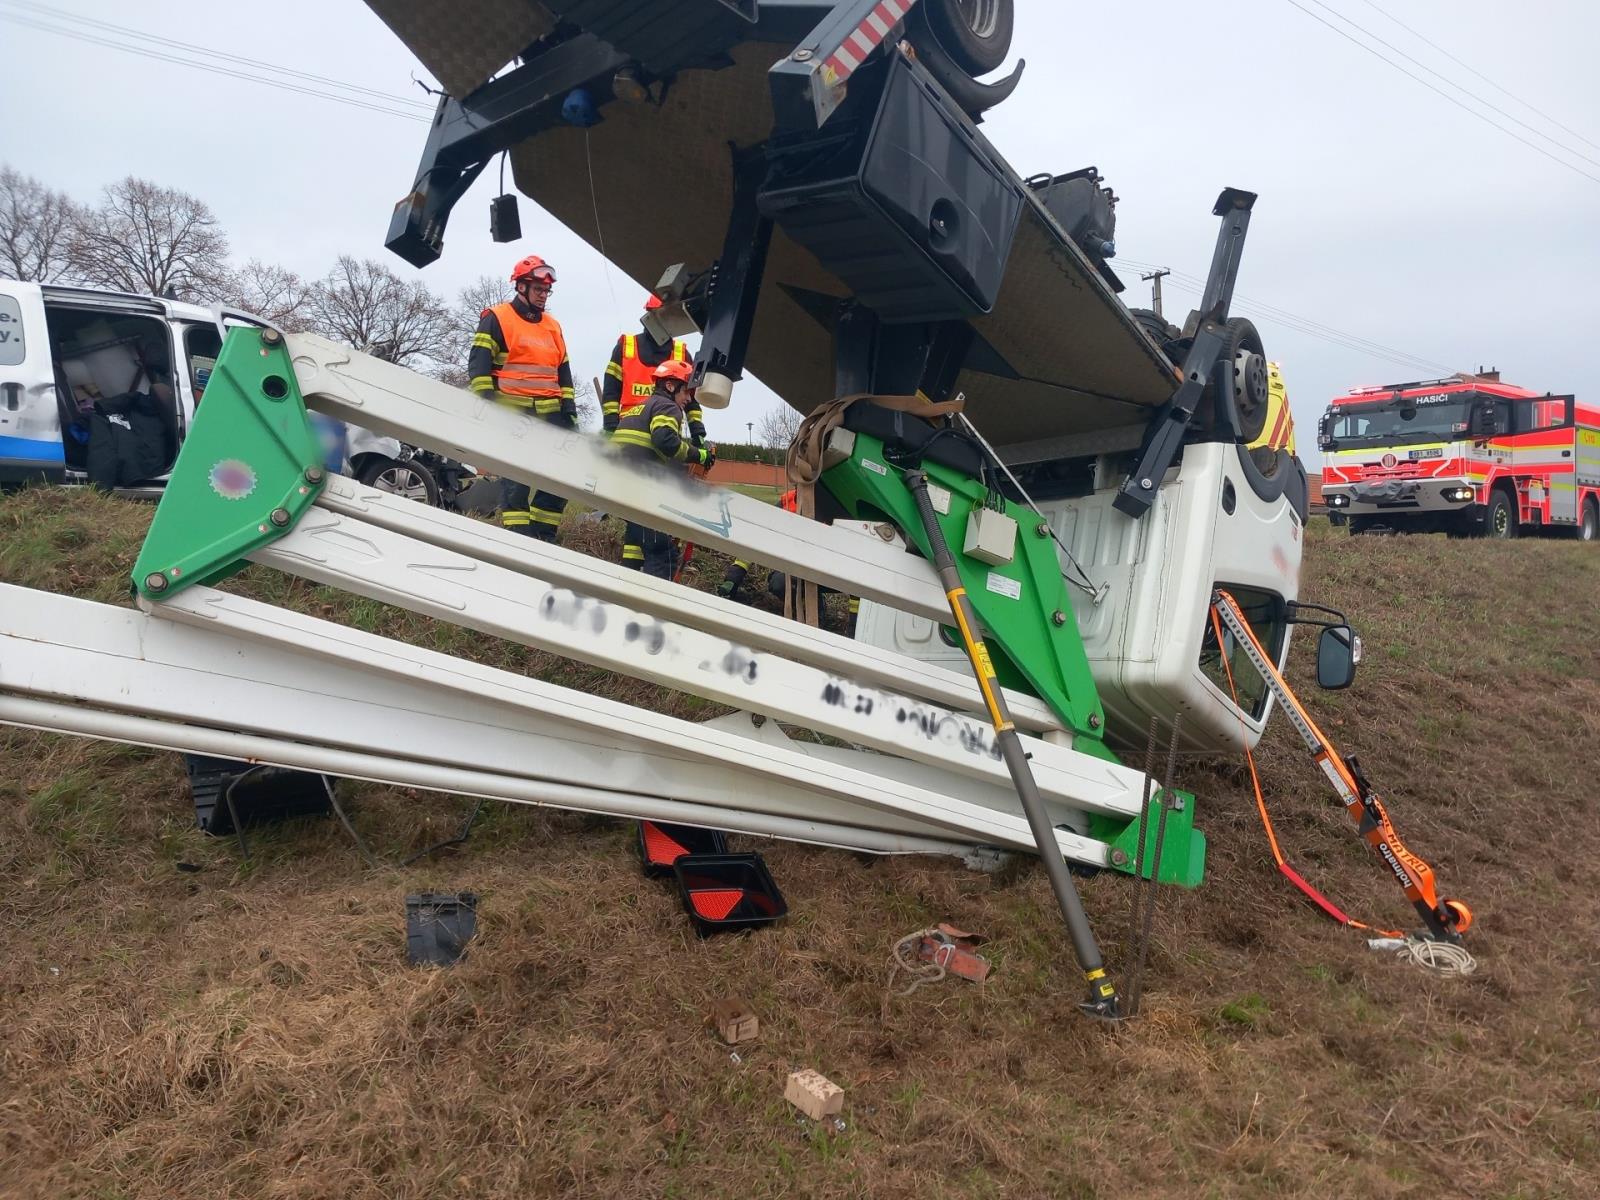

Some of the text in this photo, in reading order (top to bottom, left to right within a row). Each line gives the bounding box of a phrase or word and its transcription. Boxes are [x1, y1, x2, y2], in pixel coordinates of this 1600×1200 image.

[634, 385, 656, 395] HAS
[1416, 393, 1448, 404] HASIČI
[1379, 843, 1412, 889] holmatro
